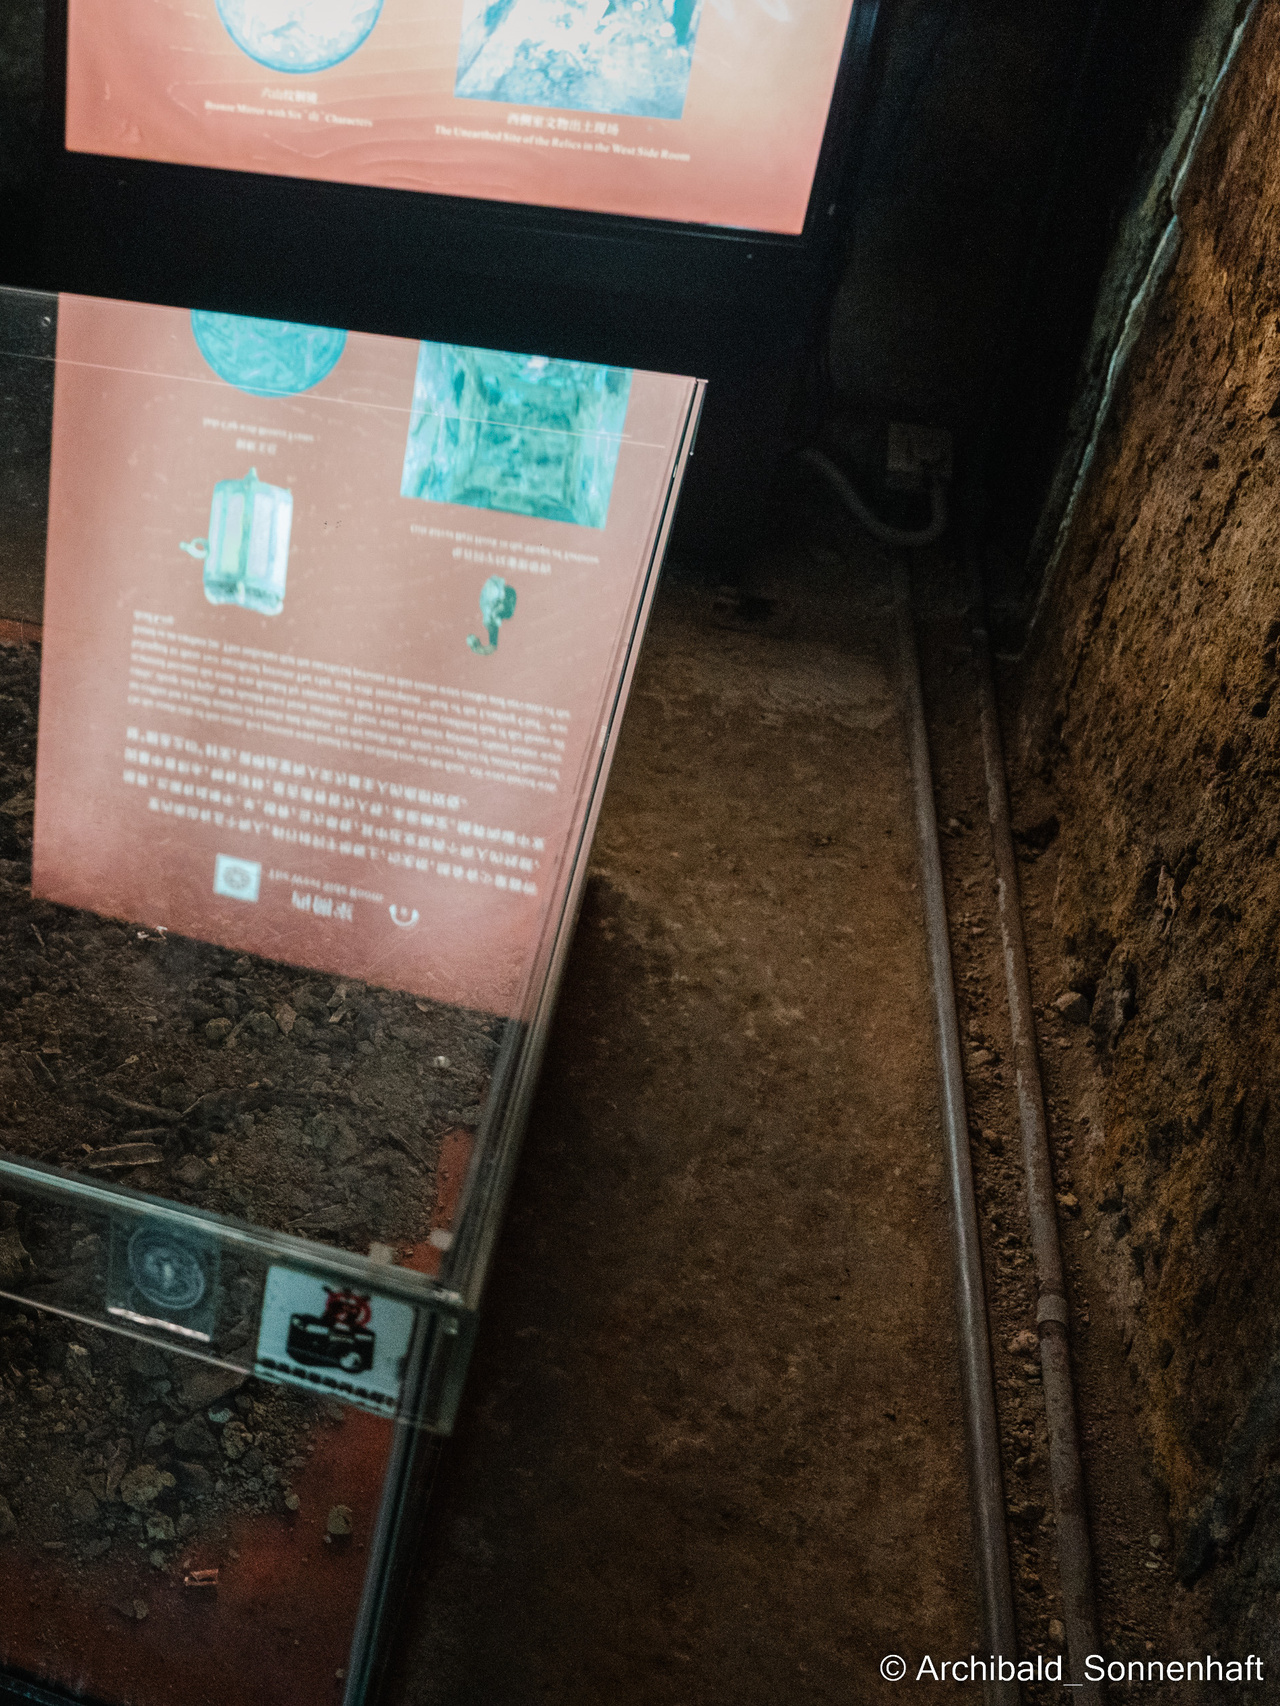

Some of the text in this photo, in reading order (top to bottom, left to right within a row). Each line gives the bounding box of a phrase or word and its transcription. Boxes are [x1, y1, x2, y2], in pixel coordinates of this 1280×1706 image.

[435, 124, 452, 136] The
[535, 135, 551, 147] the
[595, 142, 611, 153] the
